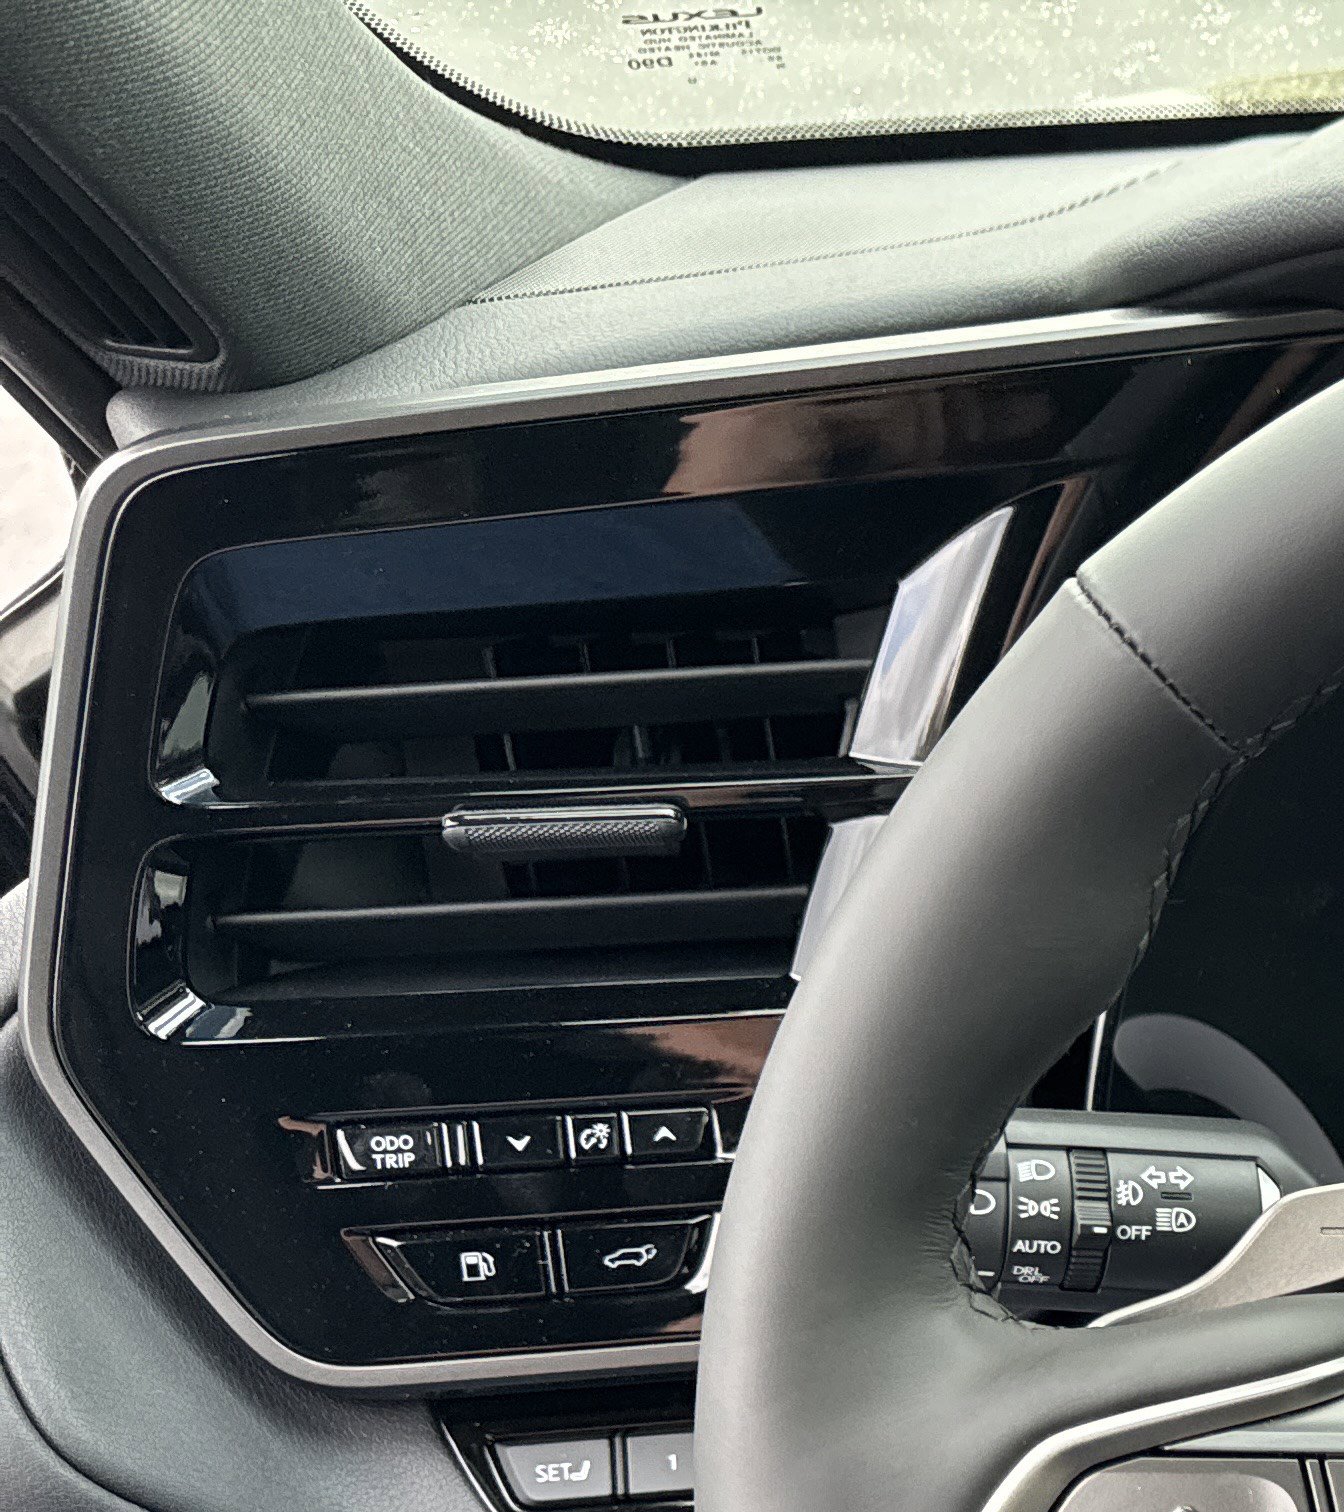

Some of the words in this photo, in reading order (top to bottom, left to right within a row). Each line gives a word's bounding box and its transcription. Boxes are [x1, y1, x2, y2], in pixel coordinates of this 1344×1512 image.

[370, 1135, 414, 1151] ODO
[371, 1153, 416, 1169] TRIP
[1116, 1225, 1152, 1241] OFF
[1012, 1239, 1061, 1255] AUTO
[667, 1454, 678, 1471] 1
[534, 1462, 572, 1483] SET
